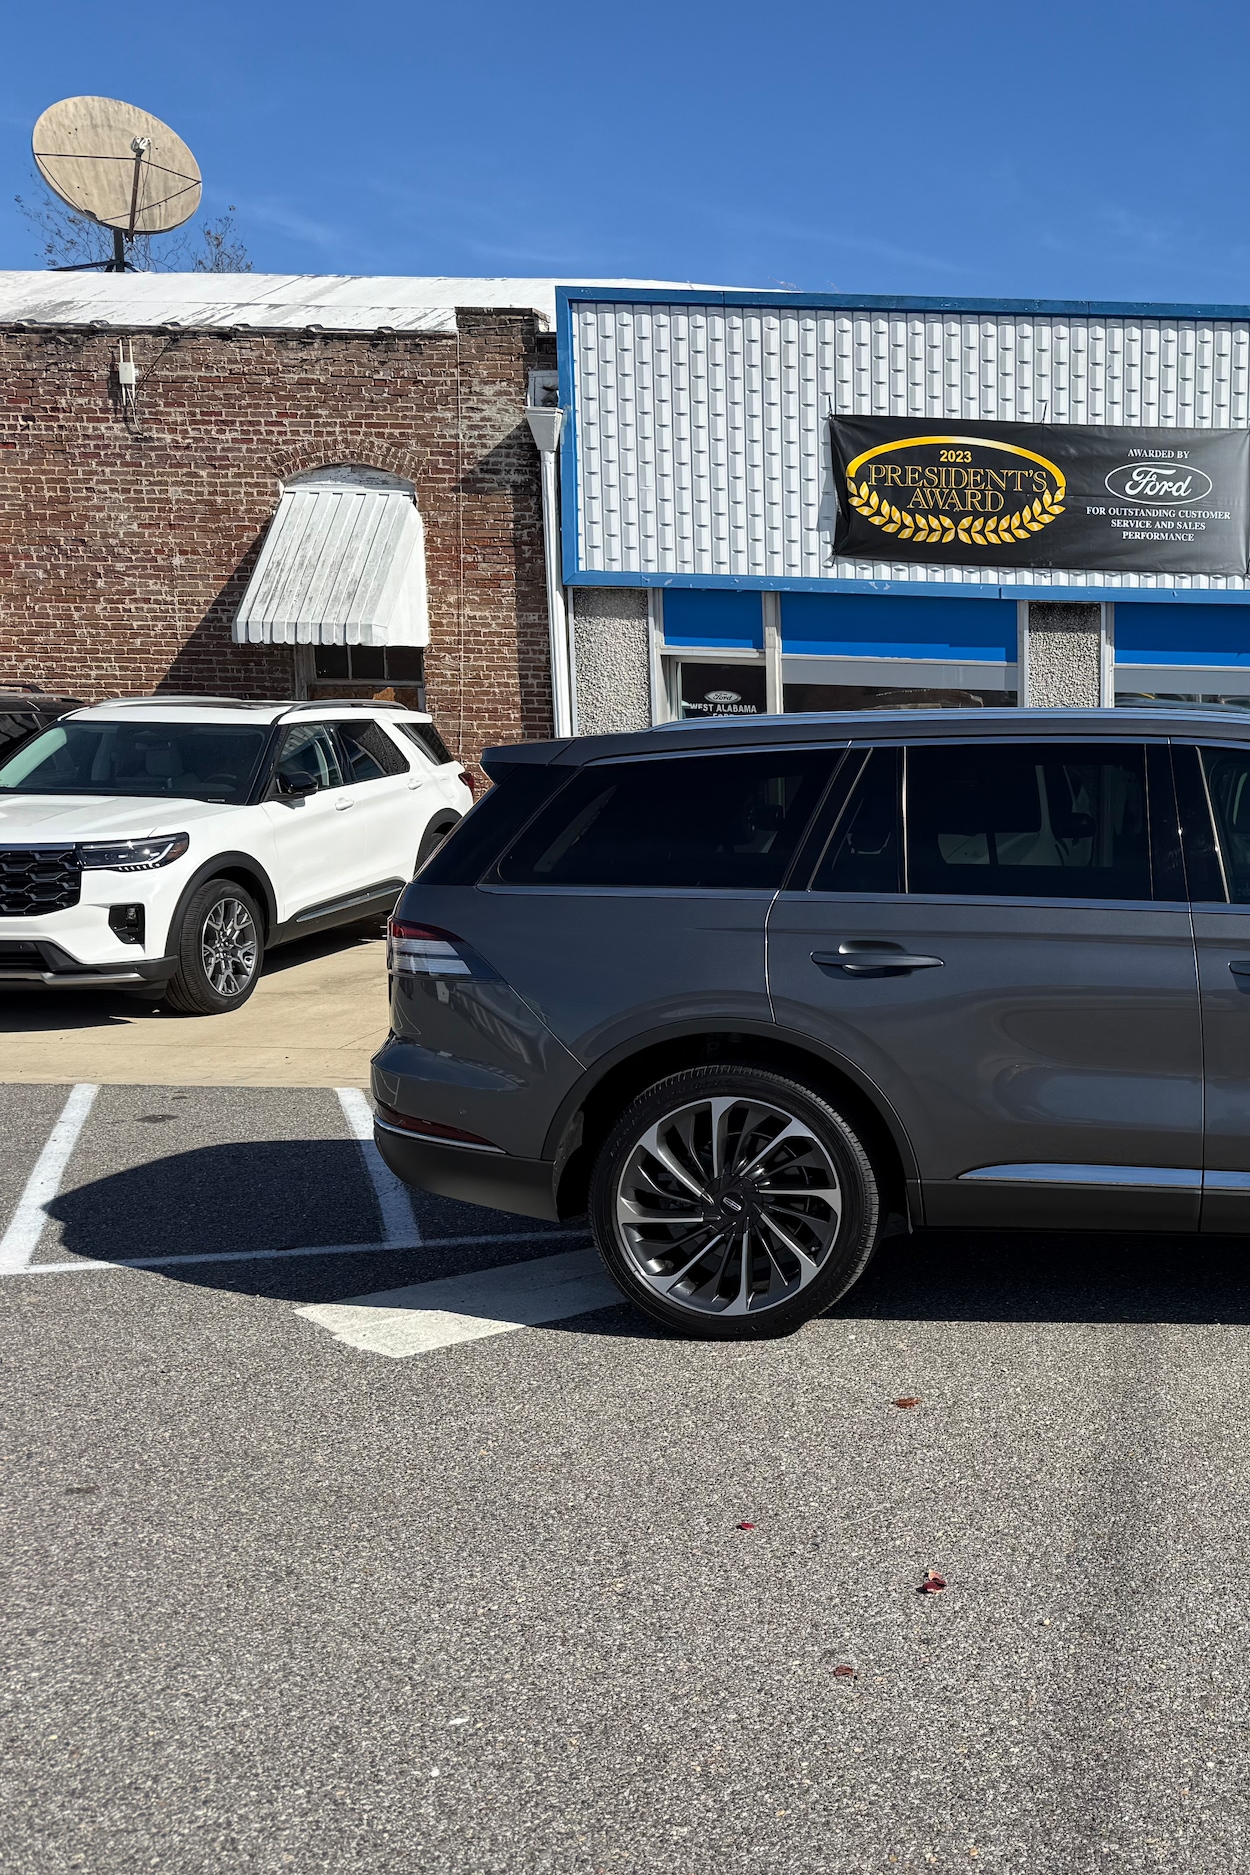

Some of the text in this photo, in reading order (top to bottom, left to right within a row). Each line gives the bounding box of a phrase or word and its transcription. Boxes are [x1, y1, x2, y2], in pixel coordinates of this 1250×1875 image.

[940, 450, 972, 463] 2023
[1128, 449, 1190, 459] AWARDED BY
[868, 464, 1047, 492] PRESIDENT'S
[1125, 467, 1193, 497] Ford
[907, 487, 1005, 512] AWARD
[1086, 506, 1231, 520] FOR OUTSTANDING CUSTOMER
[1111, 519, 1206, 530] SERVICE AND SALES
[1122, 531, 1194, 542] PERFORMANCE
[712, 693, 733, 701] Ford
[690, 703, 757, 713] WEST ALABAMA
